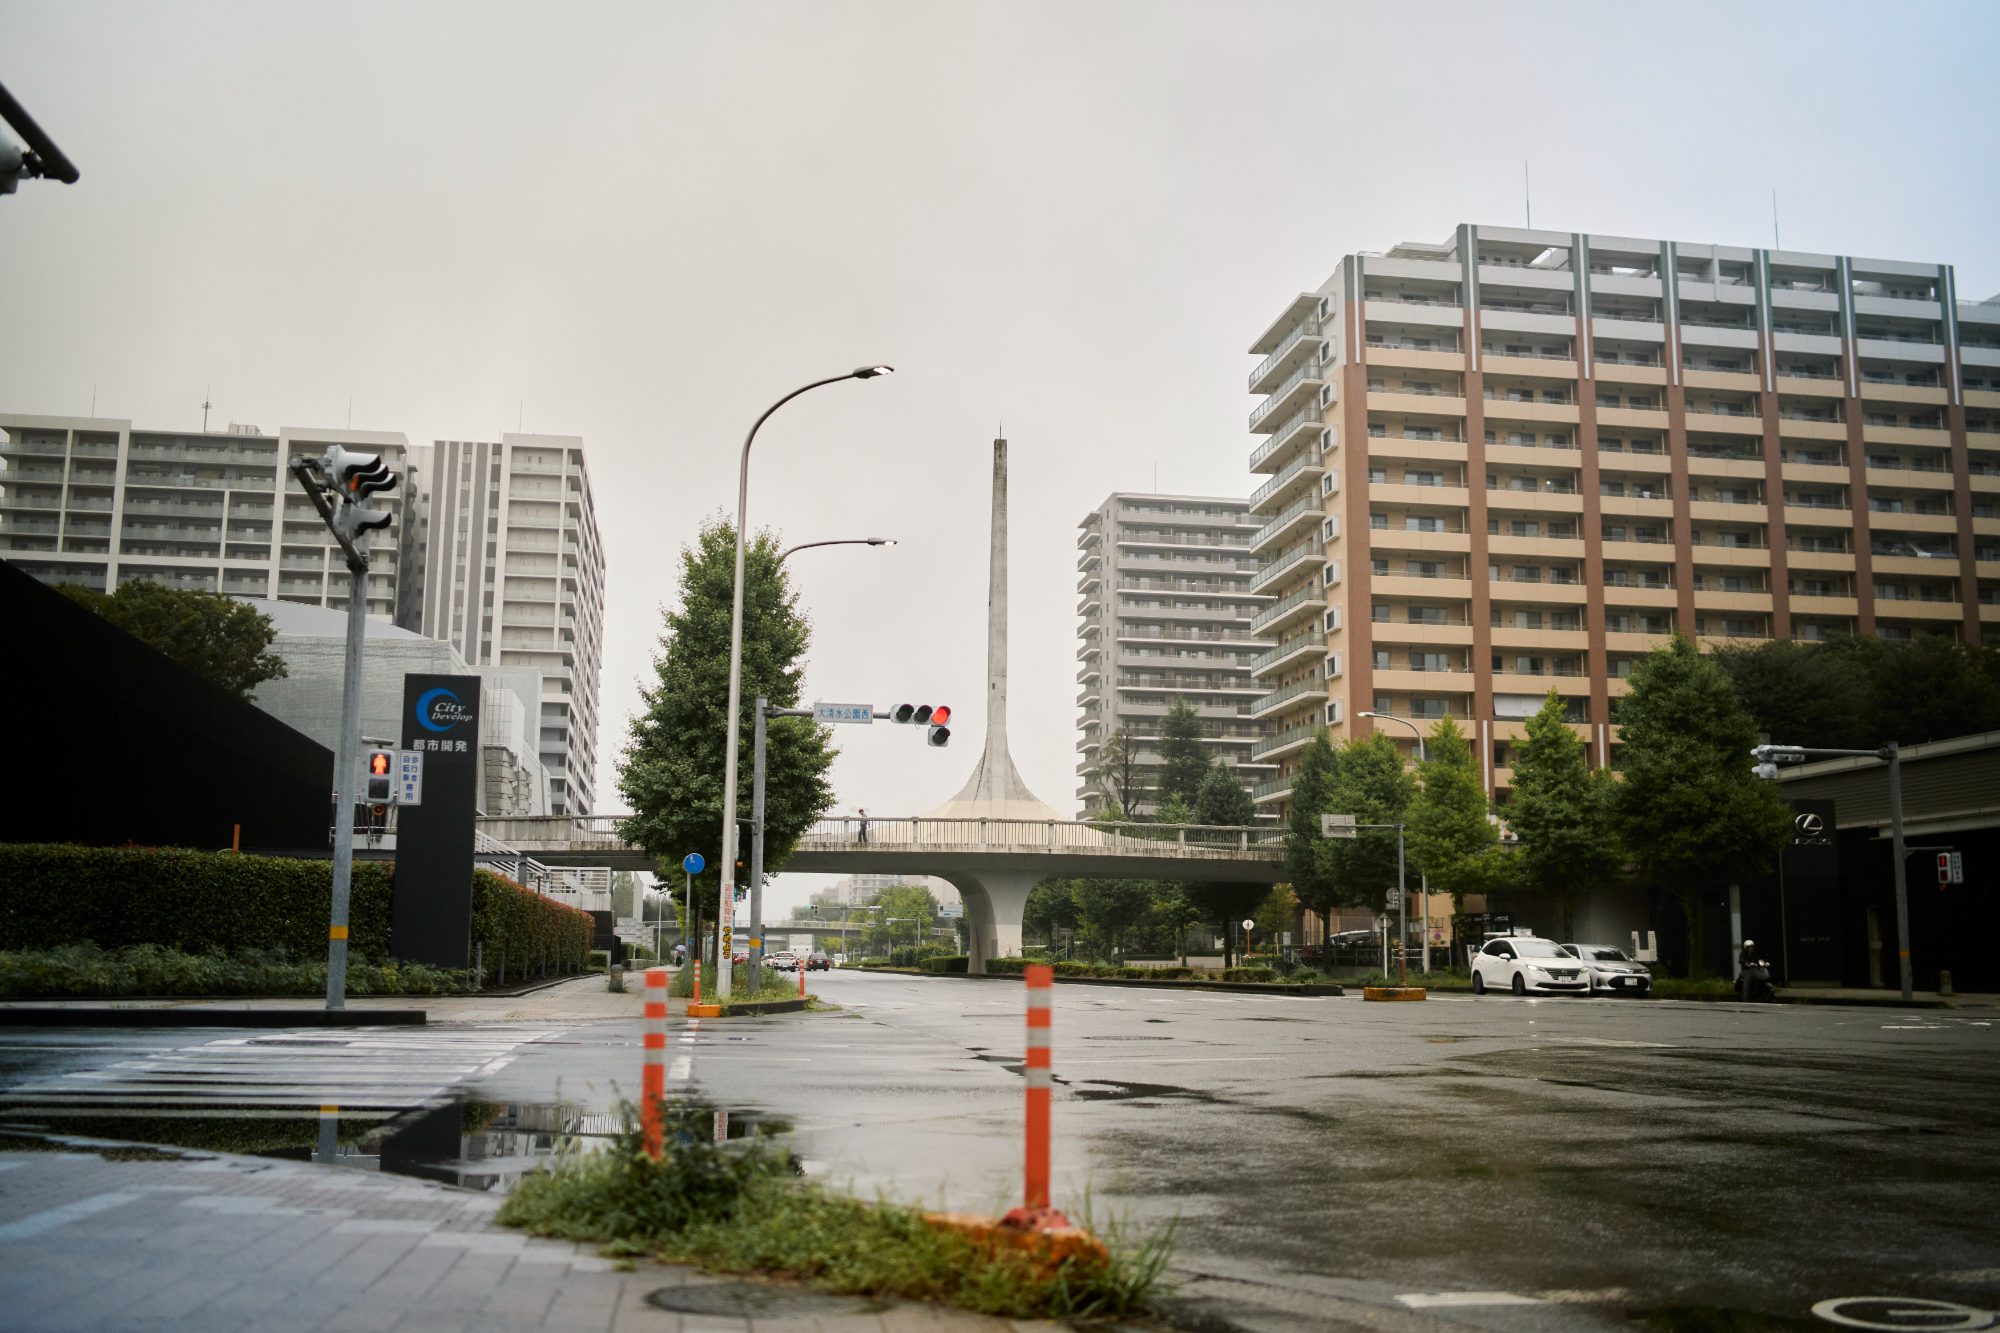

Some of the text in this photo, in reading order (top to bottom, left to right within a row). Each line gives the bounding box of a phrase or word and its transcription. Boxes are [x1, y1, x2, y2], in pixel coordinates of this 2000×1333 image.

[435, 702, 466, 714] City
[818, 706, 869, 719] 大清水公園西
[432, 712, 473, 722] Develop
[413, 739, 468, 752] 都市開発
